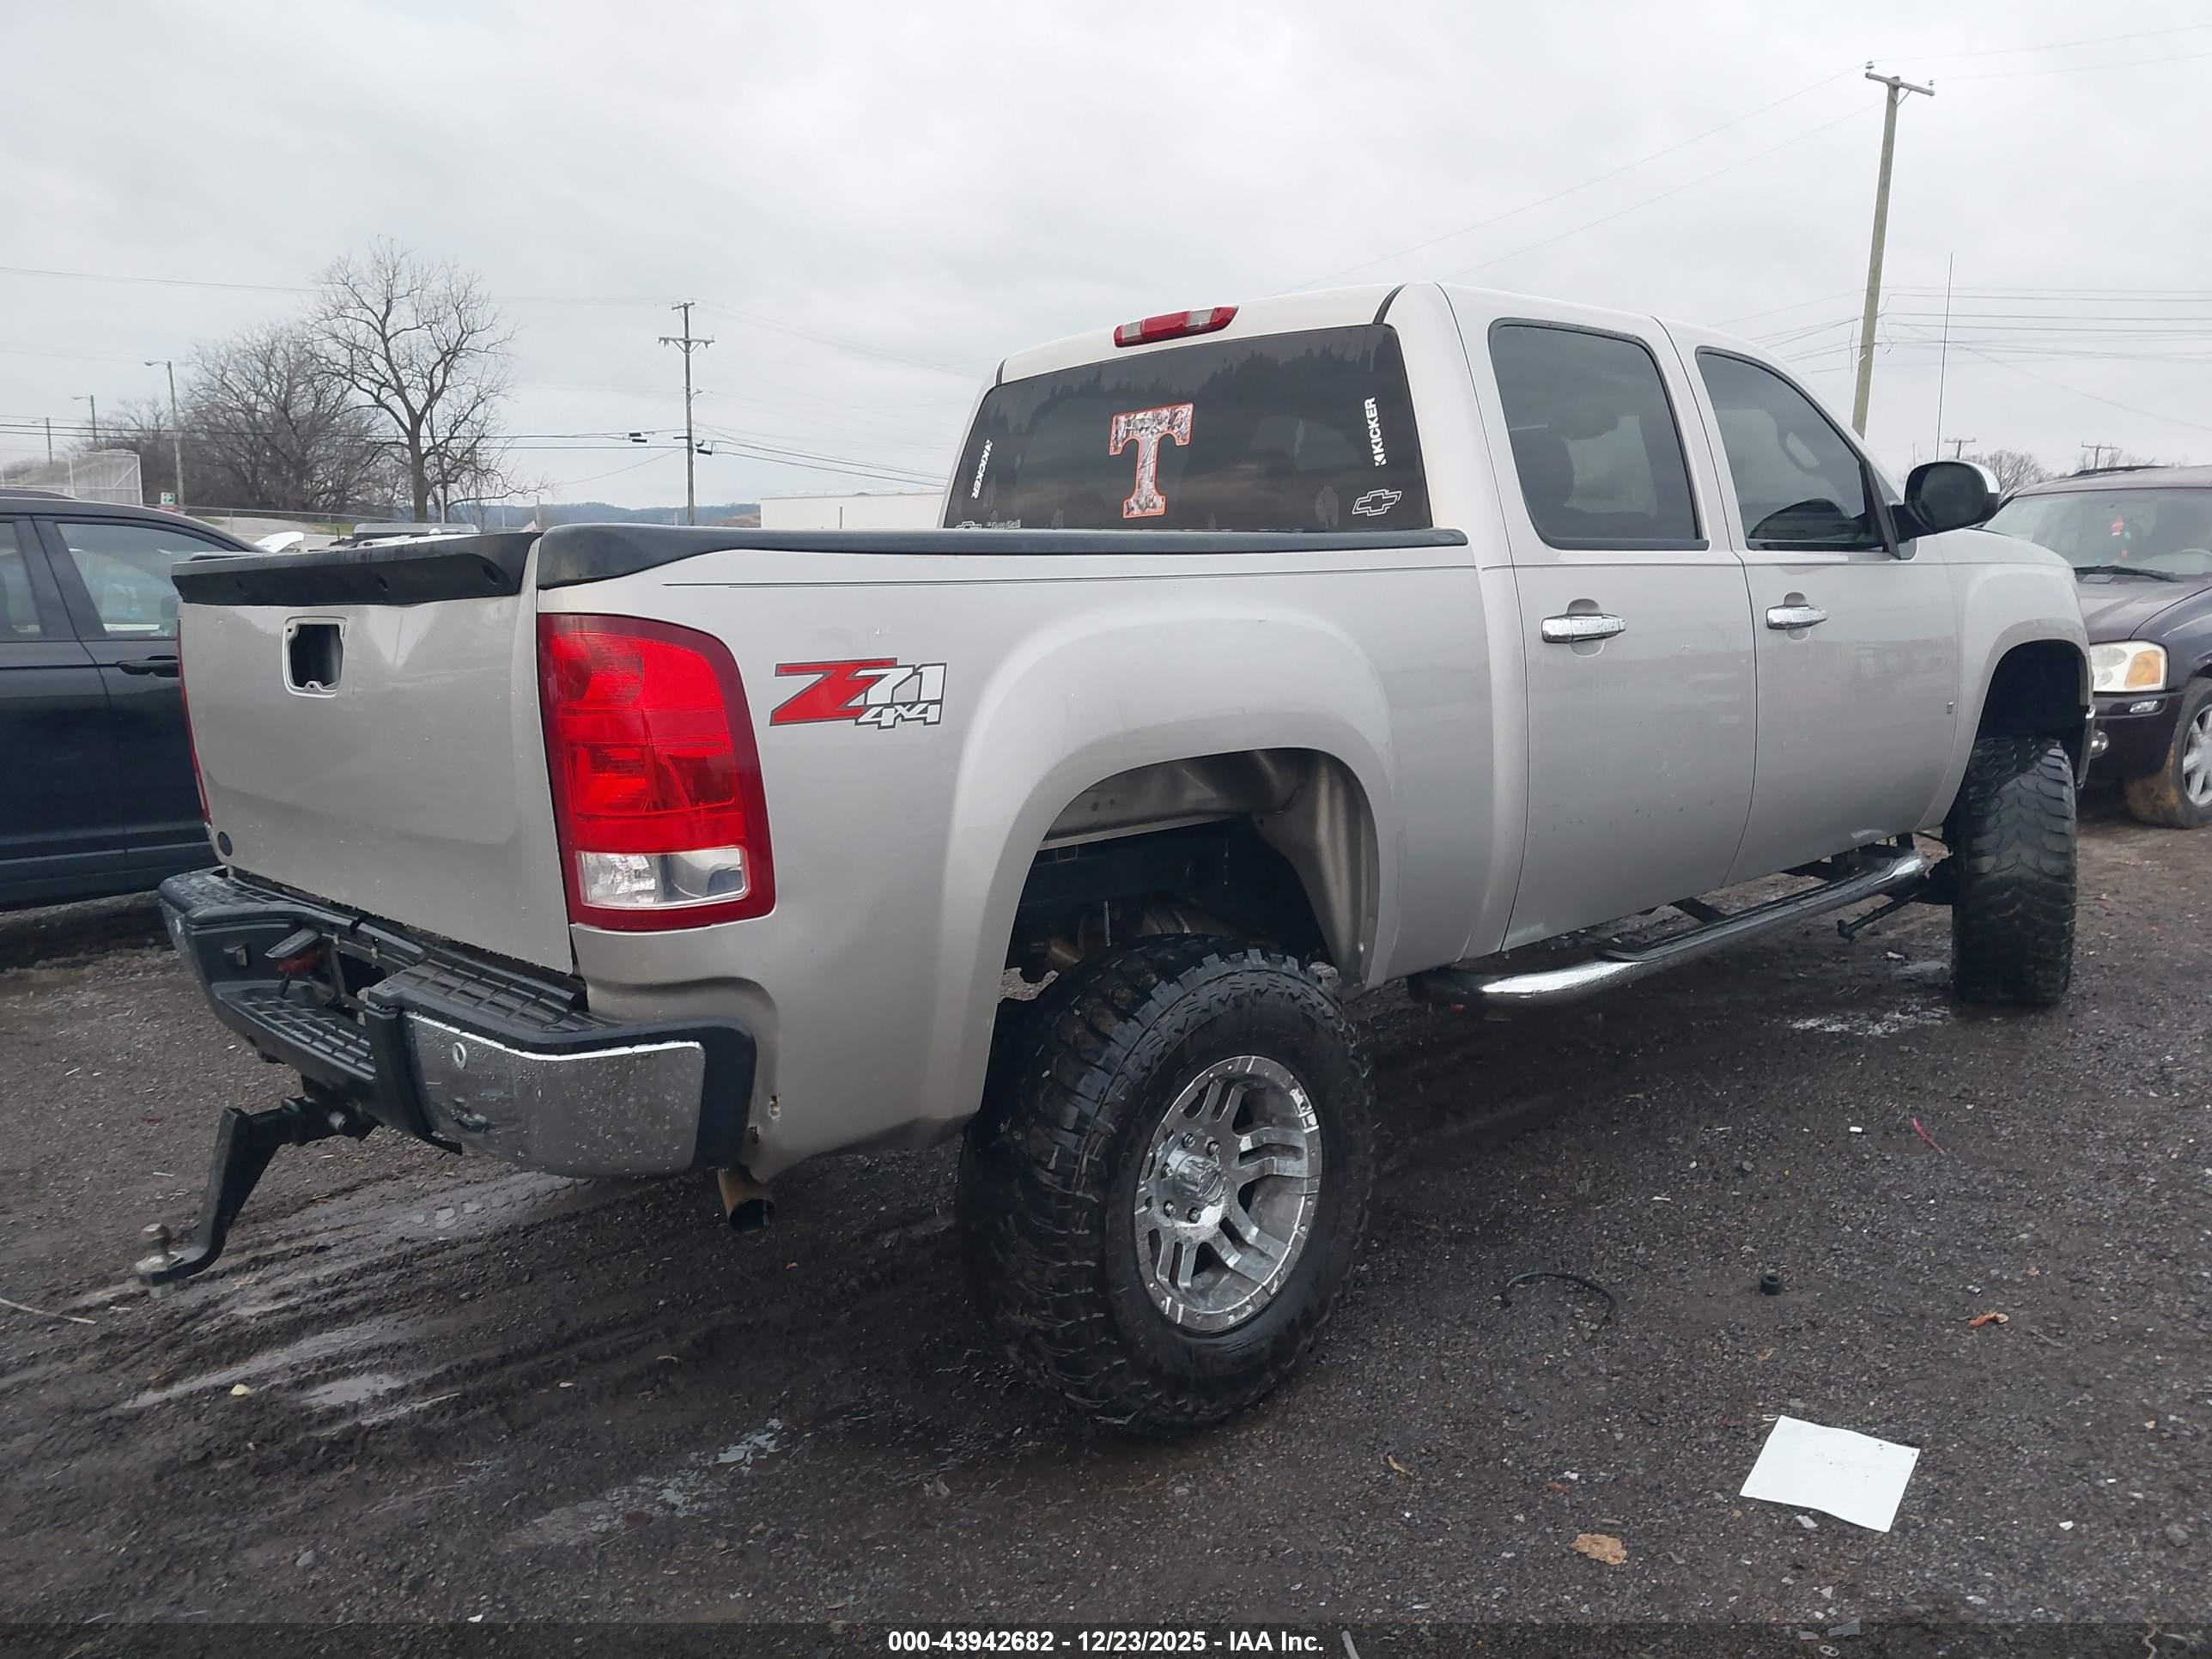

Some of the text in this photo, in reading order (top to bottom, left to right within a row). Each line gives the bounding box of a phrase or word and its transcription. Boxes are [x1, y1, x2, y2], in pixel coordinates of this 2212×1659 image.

[1364, 397, 1385, 454] KICKER
[971, 448, 990, 499] KICKER
[1109, 403, 1194, 518] T
[769, 658, 947, 726] Z71
